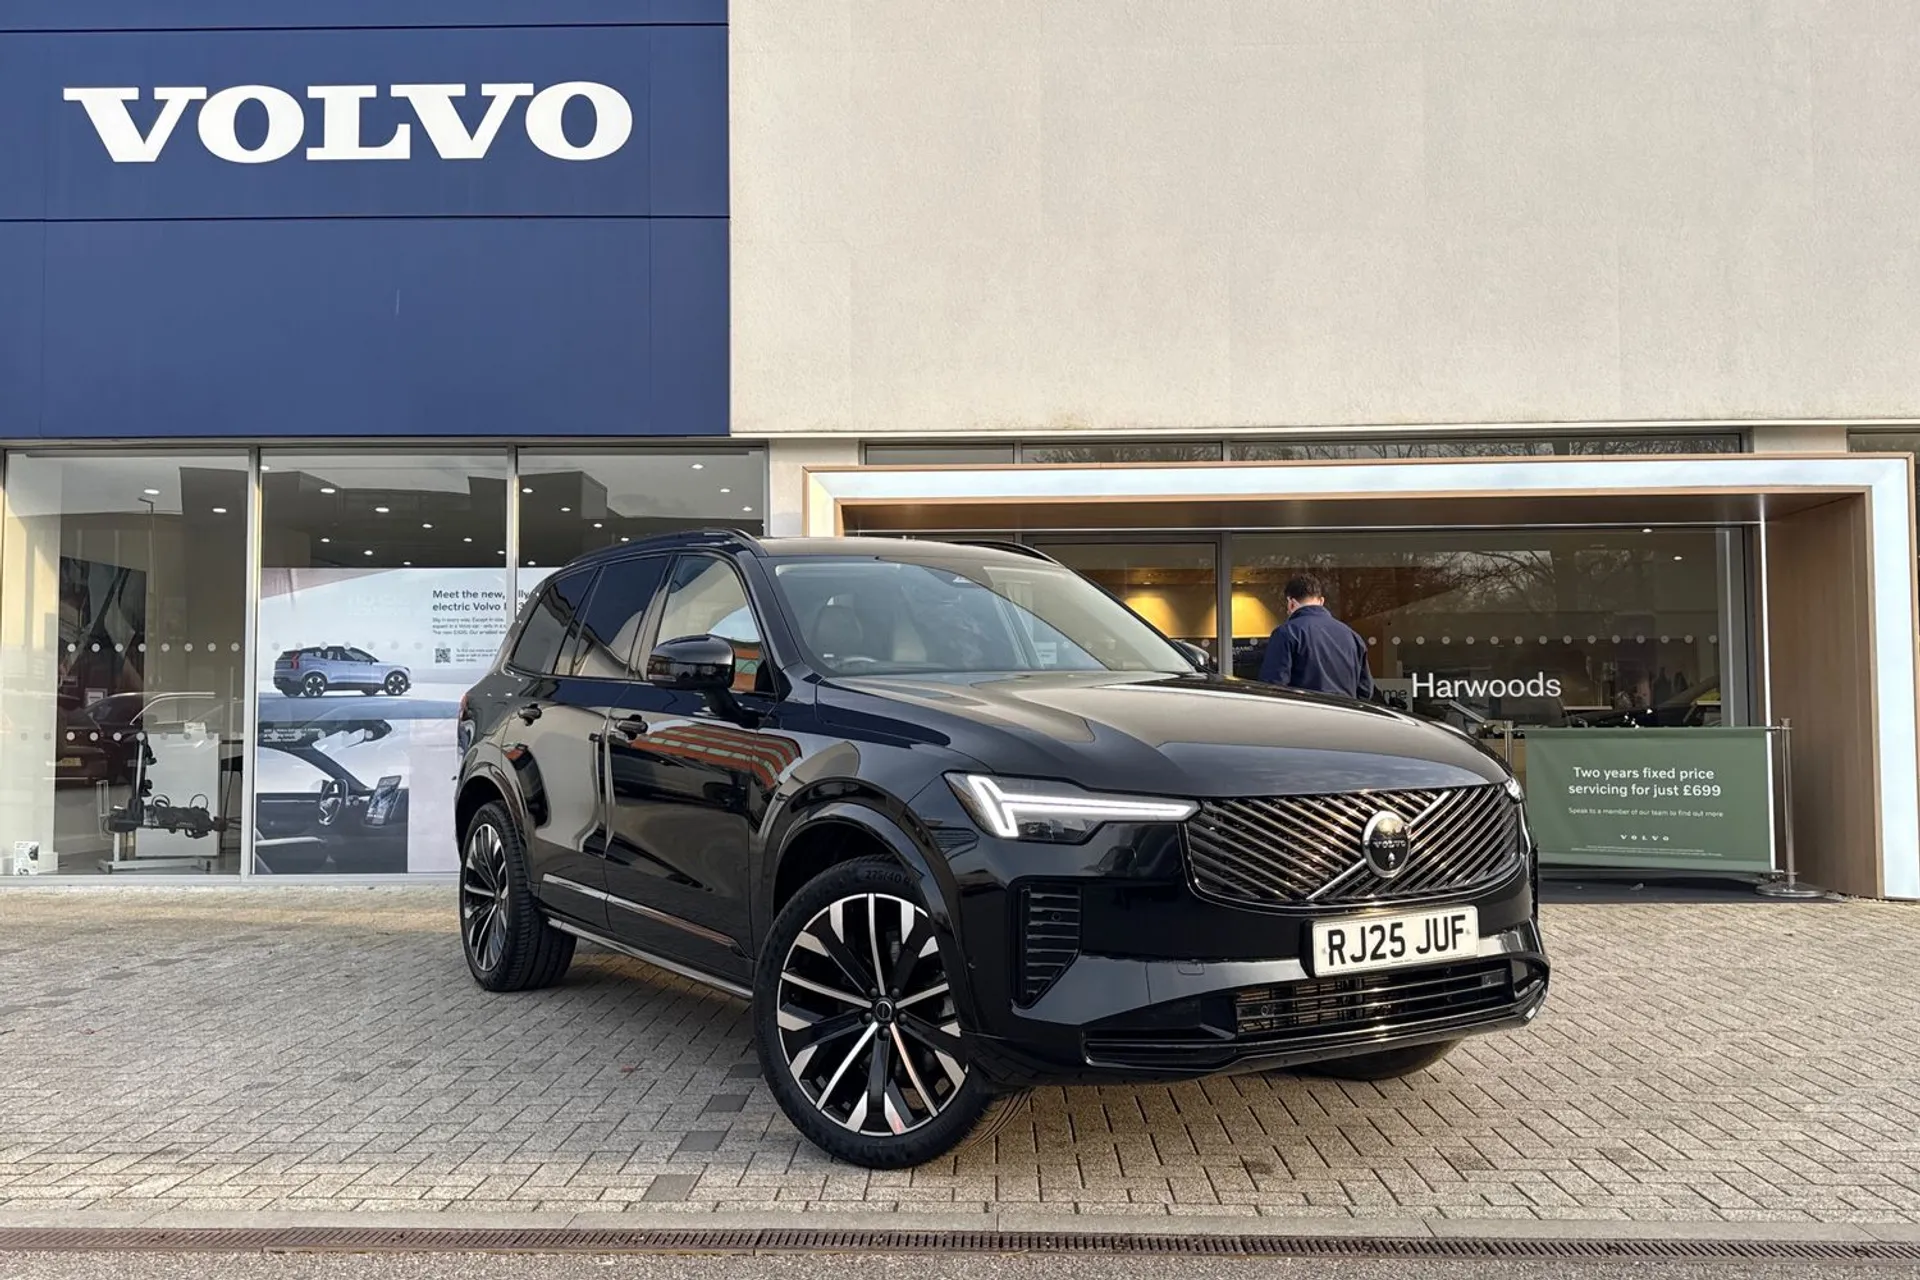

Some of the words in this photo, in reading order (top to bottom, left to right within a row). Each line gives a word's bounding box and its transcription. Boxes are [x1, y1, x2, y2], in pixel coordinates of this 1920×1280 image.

[63, 81, 633, 163] VOLVO
[432, 590, 459, 599] Meet
[461, 590, 479, 599] the
[481, 592, 505, 600] new,
[432, 602, 471, 611] electric
[473, 602, 501, 611] Volvo
[1411, 671, 1562, 698] Harwoods
[1573, 767, 1600, 779] Two
[1604, 769, 1640, 781] years
[1643, 767, 1676, 779] fixed
[1679, 768, 1715, 782] price
[1568, 783, 1628, 798] servicing
[1631, 784, 1651, 796] for
[1652, 784, 1680, 798] just
[1683, 784, 1721, 797] £699
[1568, 807, 1588, 815] Speak
[1372, 839, 1407, 849] VOLVO
[1327, 921, 1406, 967] RJ25
[1416, 914, 1466, 955] JUF
